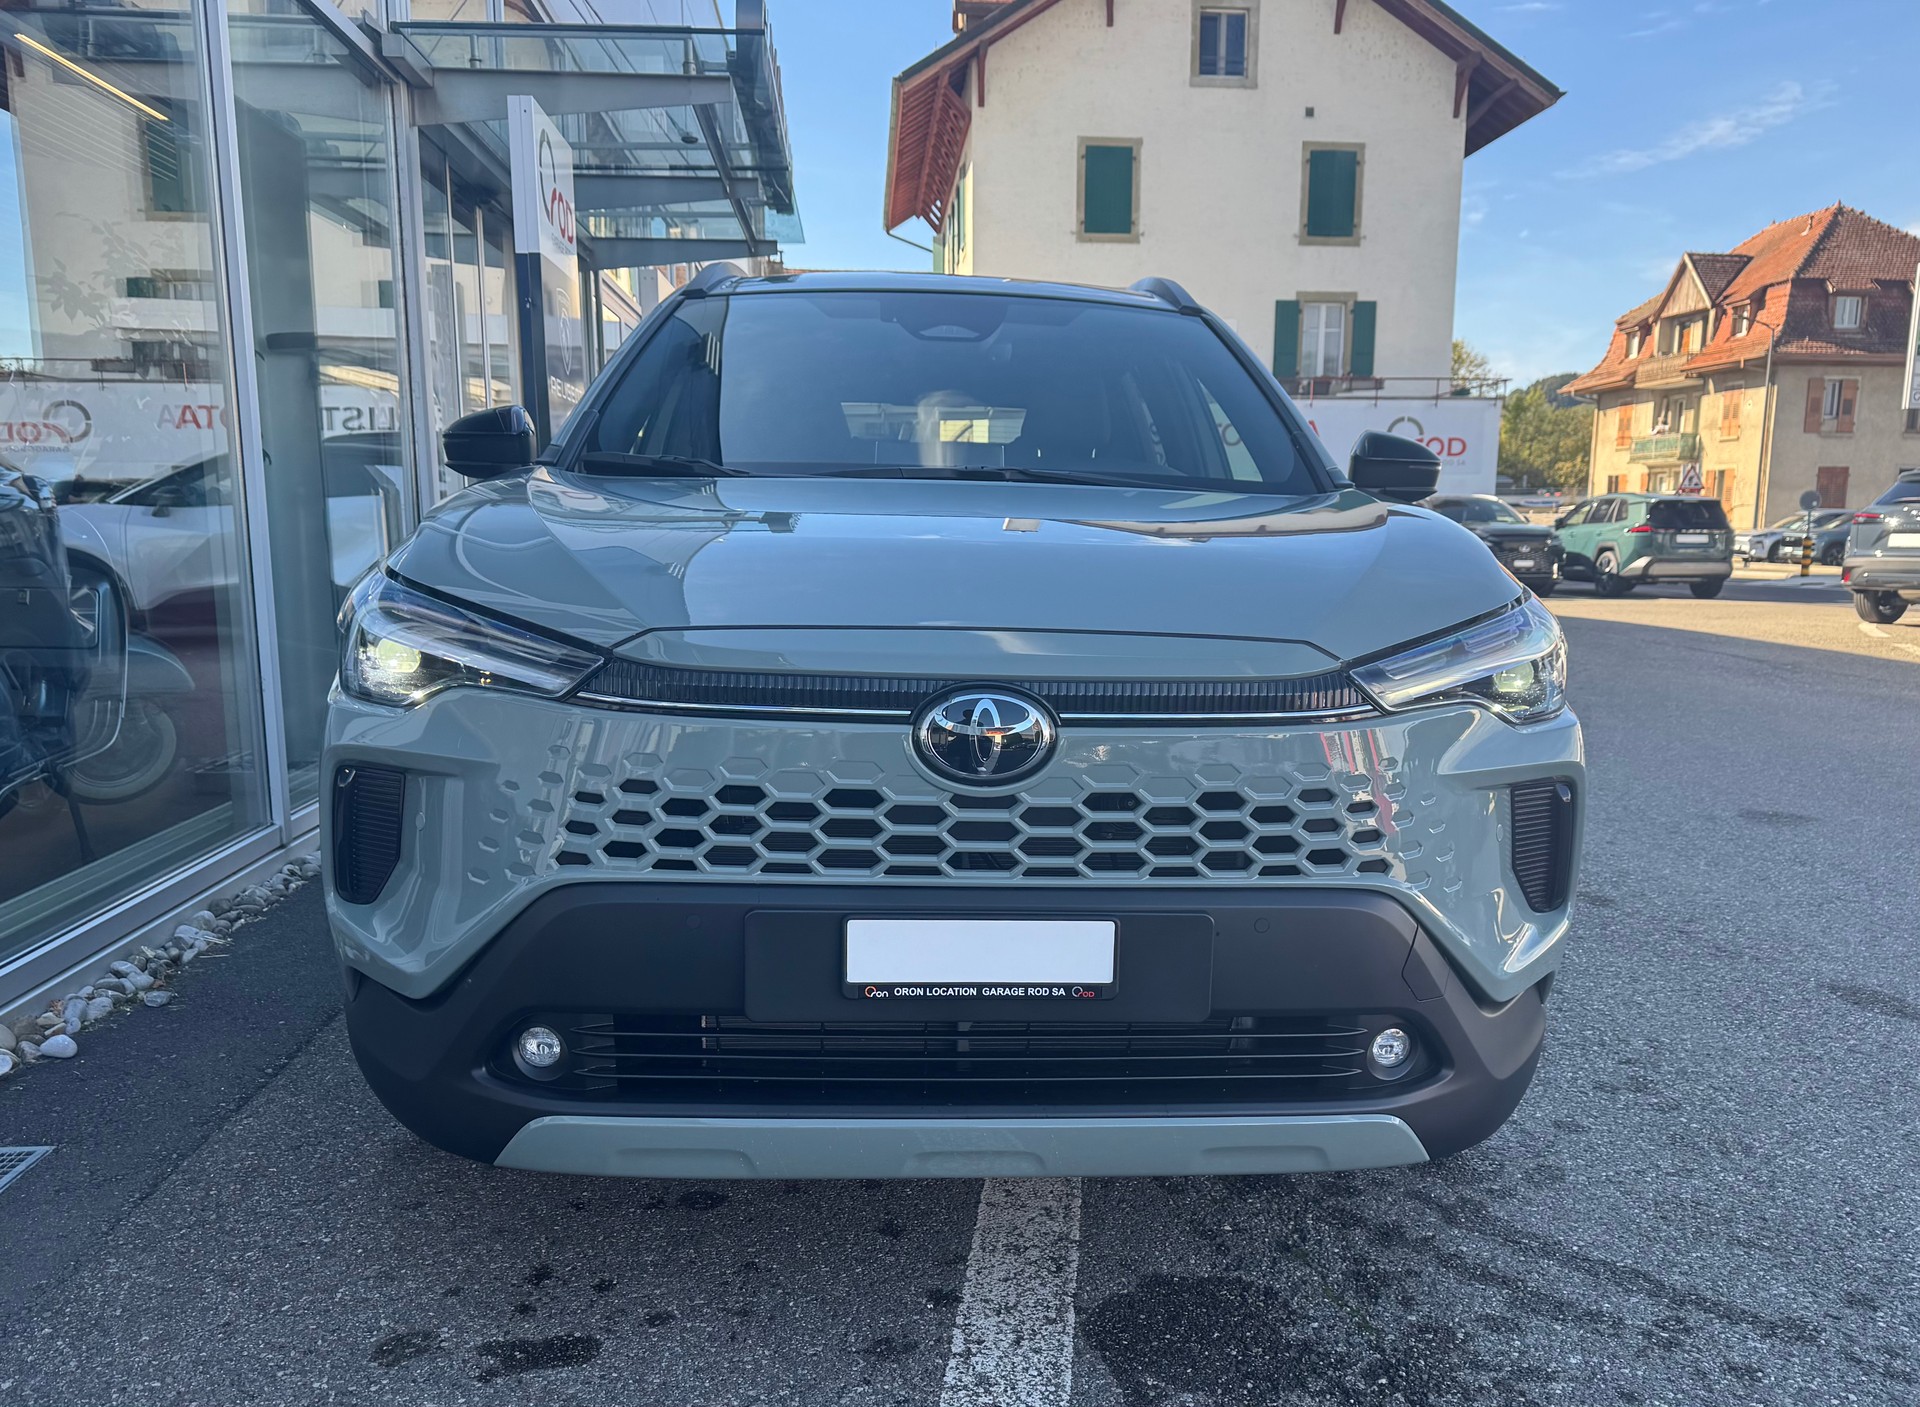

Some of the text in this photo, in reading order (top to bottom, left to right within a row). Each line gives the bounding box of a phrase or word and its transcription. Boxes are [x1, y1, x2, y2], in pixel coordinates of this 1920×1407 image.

[894, 987, 924, 996] ORON
[926, 987, 977, 996] LOCATION
[982, 987, 1025, 996] GARAGE
[1027, 987, 1050, 996] ROD
[1051, 987, 1066, 996] SA
